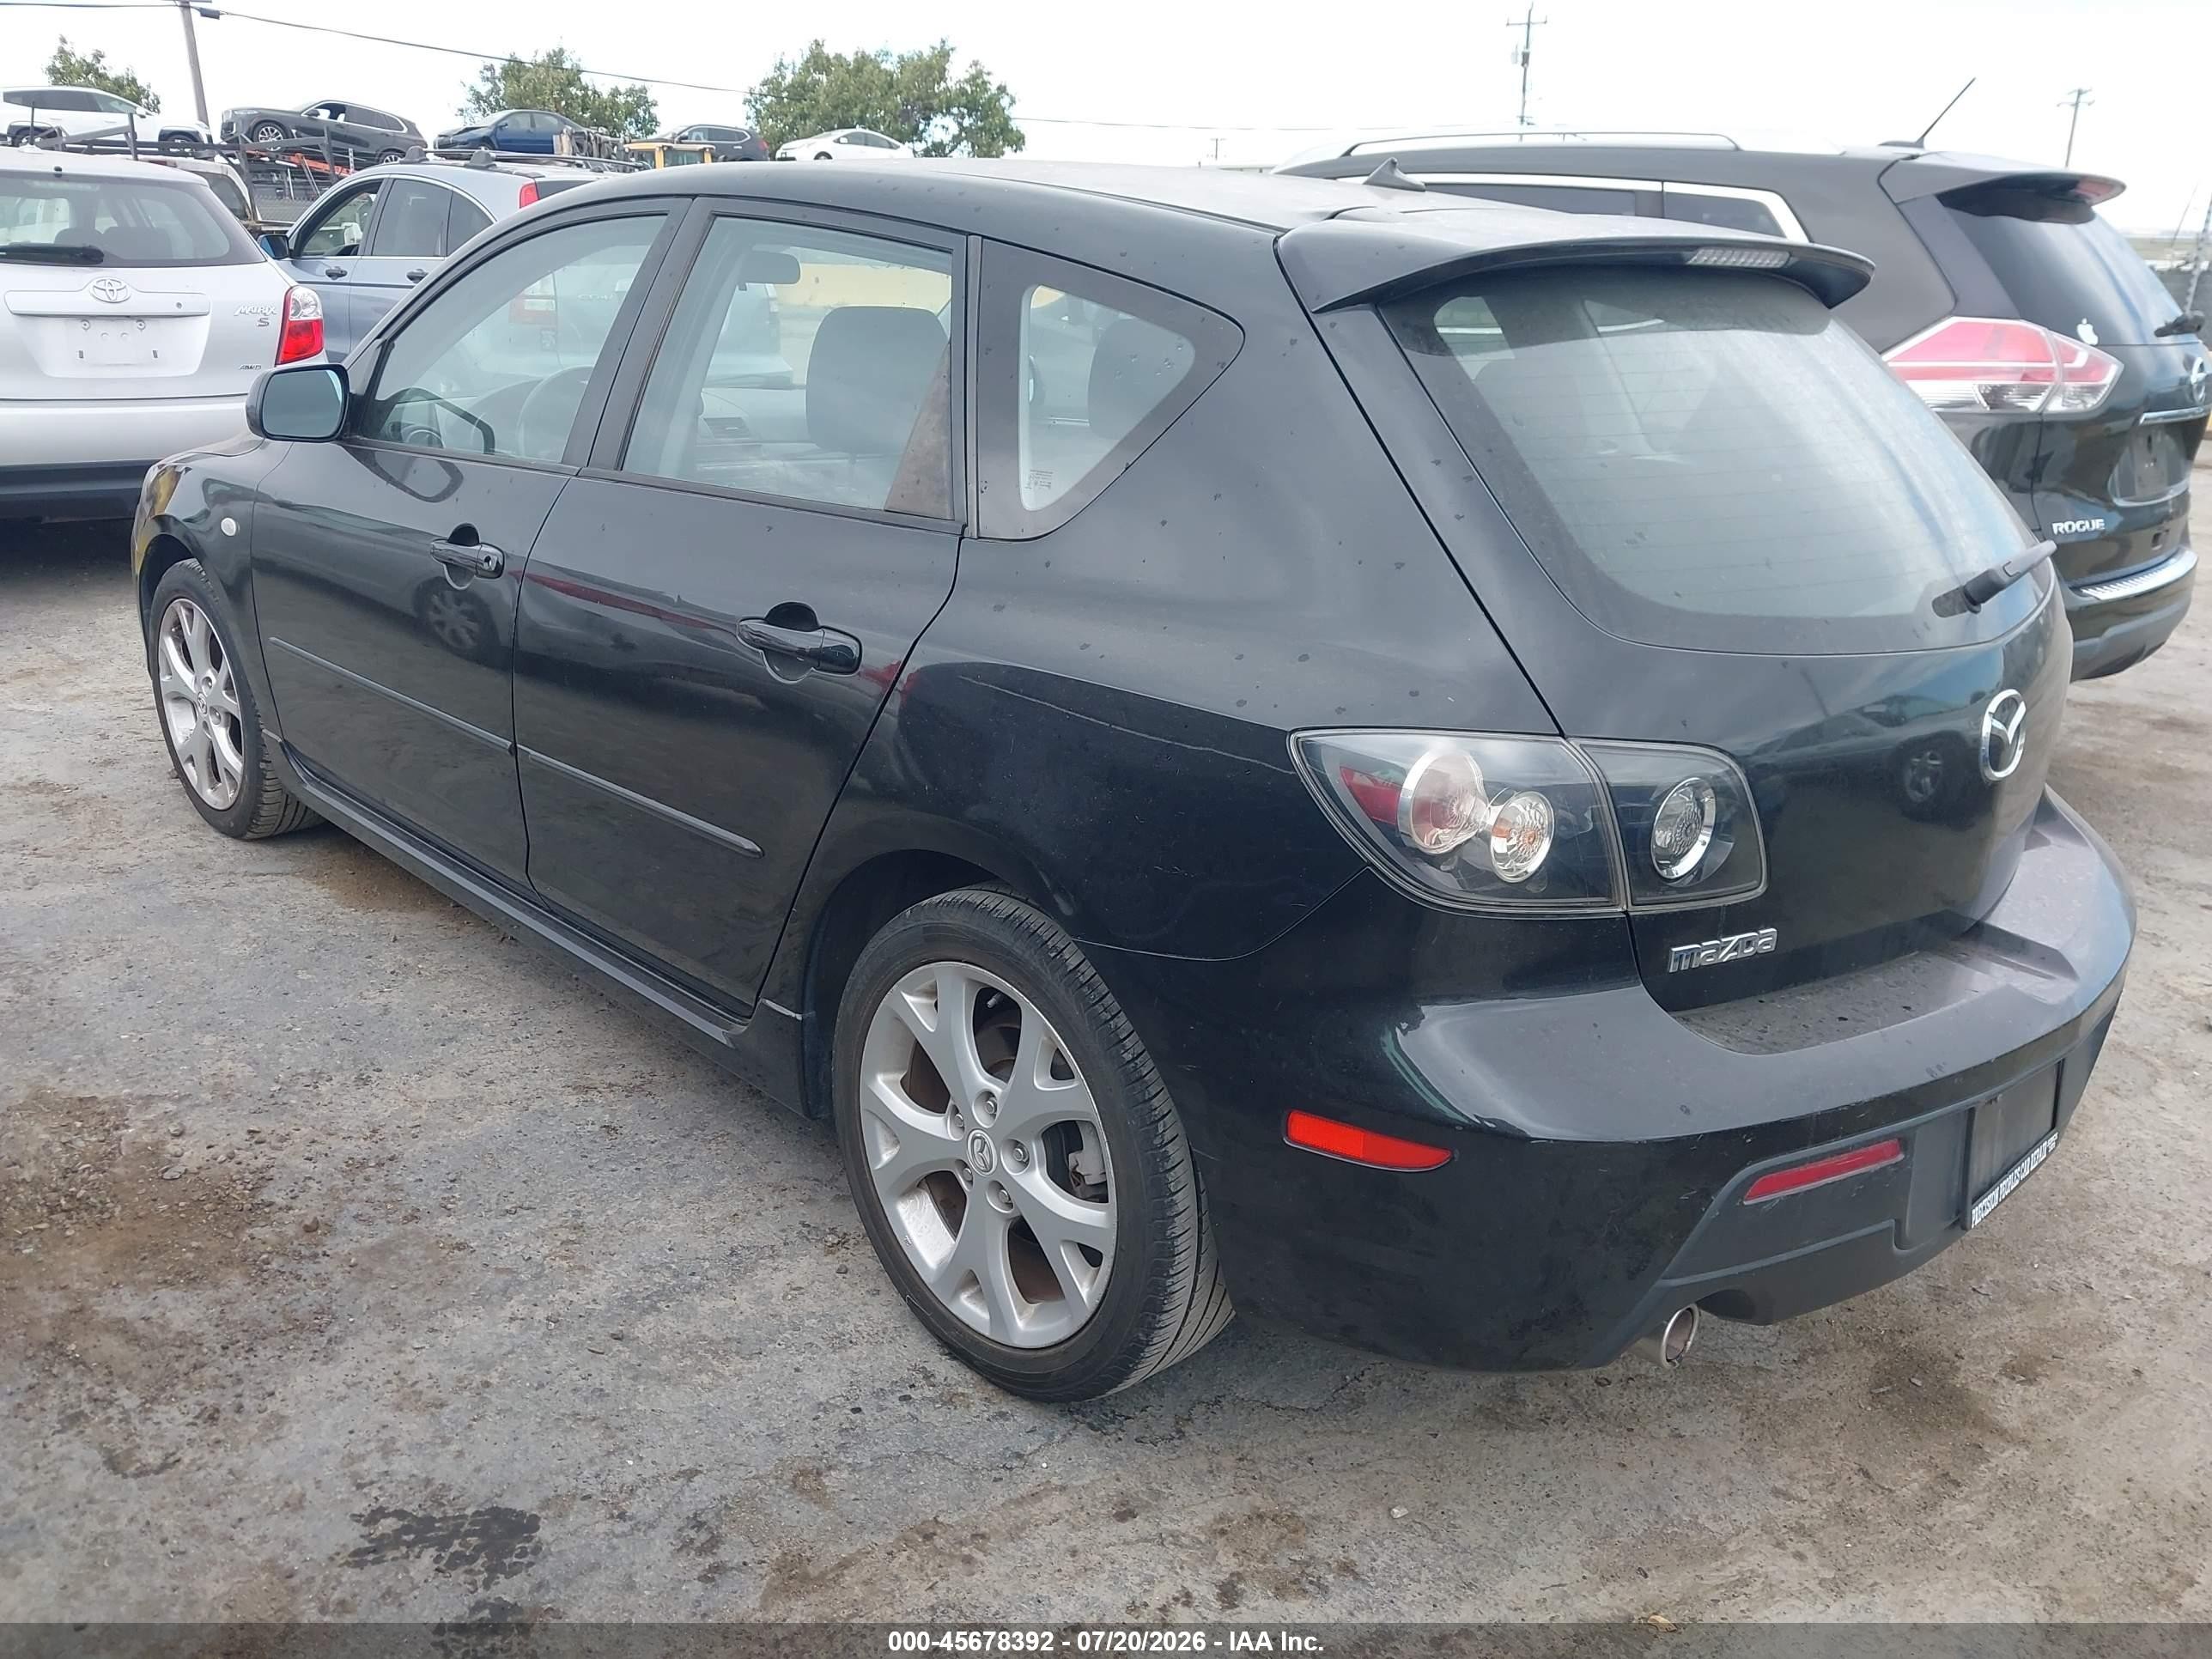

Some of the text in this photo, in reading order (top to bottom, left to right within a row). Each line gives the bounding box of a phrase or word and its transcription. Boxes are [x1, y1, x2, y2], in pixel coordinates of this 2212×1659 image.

[234, 305, 277, 316] MATRIX
[257, 317, 270, 327] S
[2051, 519, 2106, 535] ROGUE
